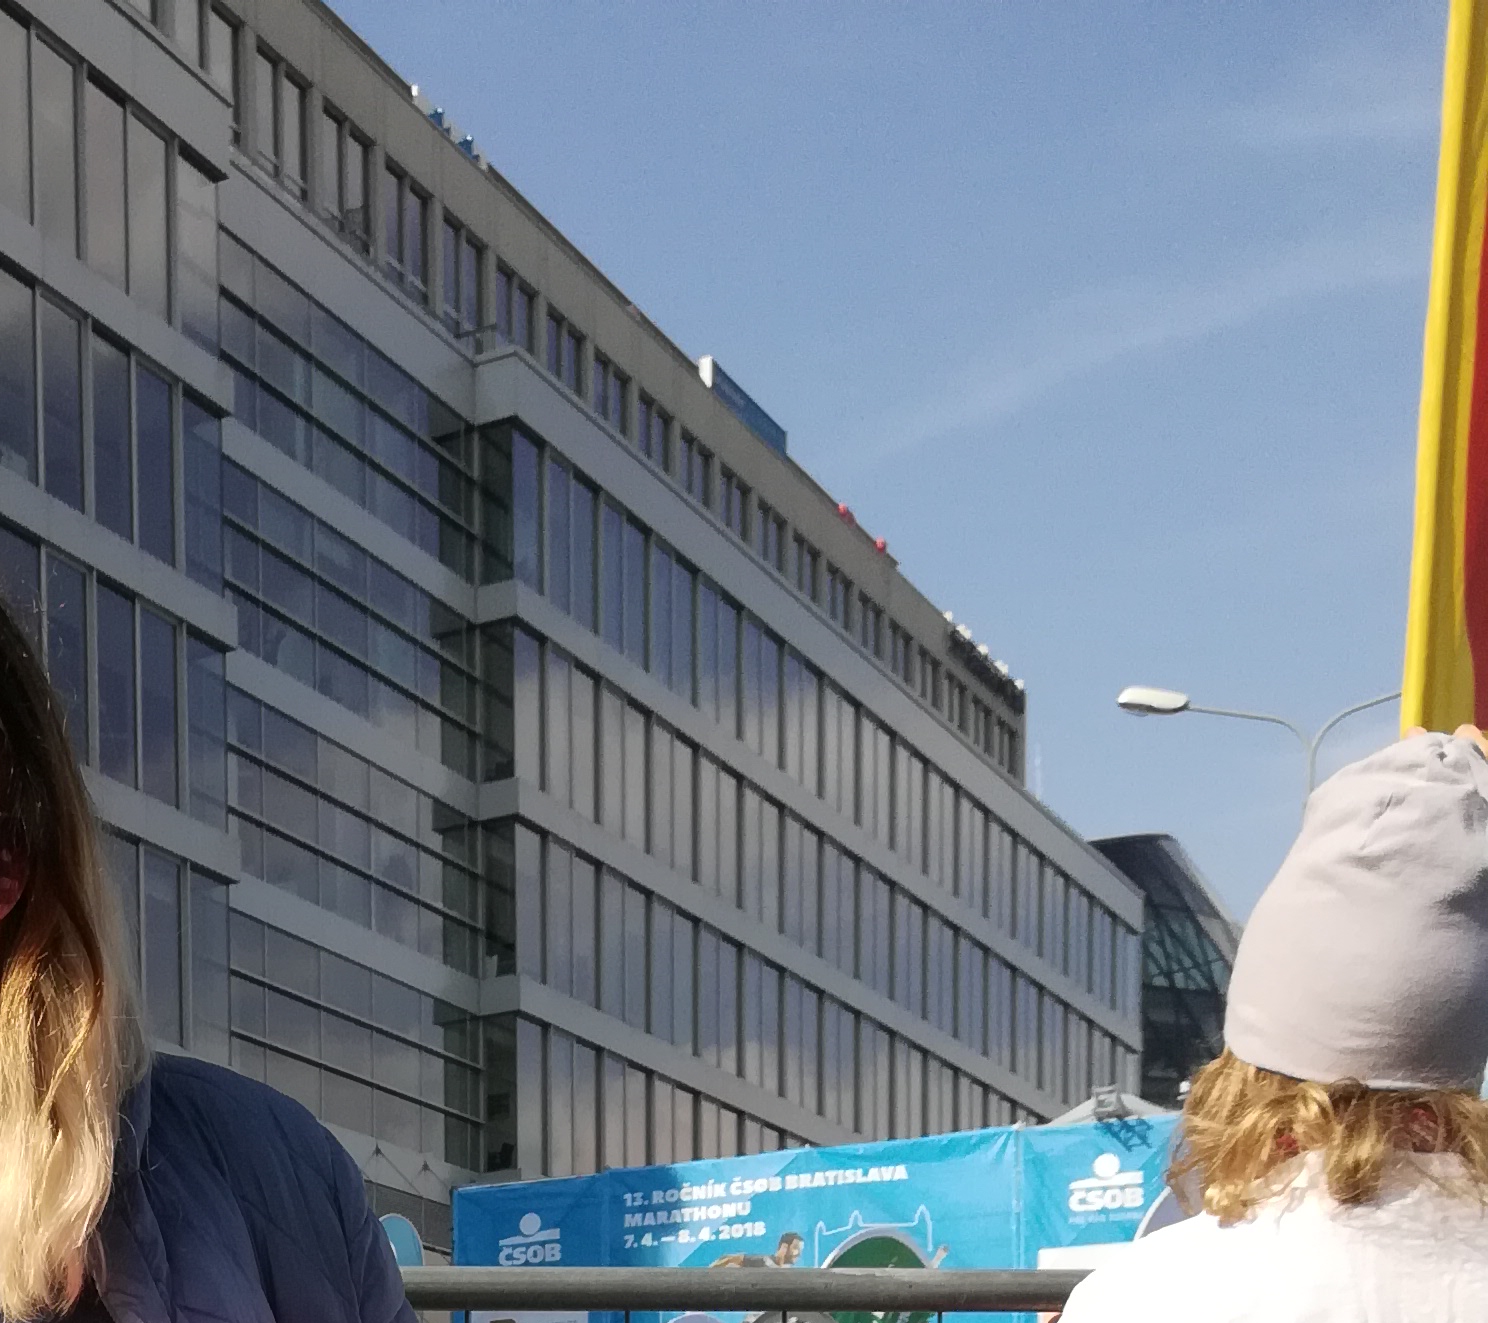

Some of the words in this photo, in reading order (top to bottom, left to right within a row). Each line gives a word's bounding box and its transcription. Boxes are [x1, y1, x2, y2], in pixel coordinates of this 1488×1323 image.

[623, 1192, 649, 1207] 13.
[652, 1179, 727, 1205] ROČNÍK
[730, 1176, 782, 1196] ČSOB
[784, 1165, 909, 1191] BRATISLAVA
[623, 1201, 752, 1228] MARATHONU
[718, 1221, 767, 1241] 2018
[498, 1242, 562, 1266] ČSOB
